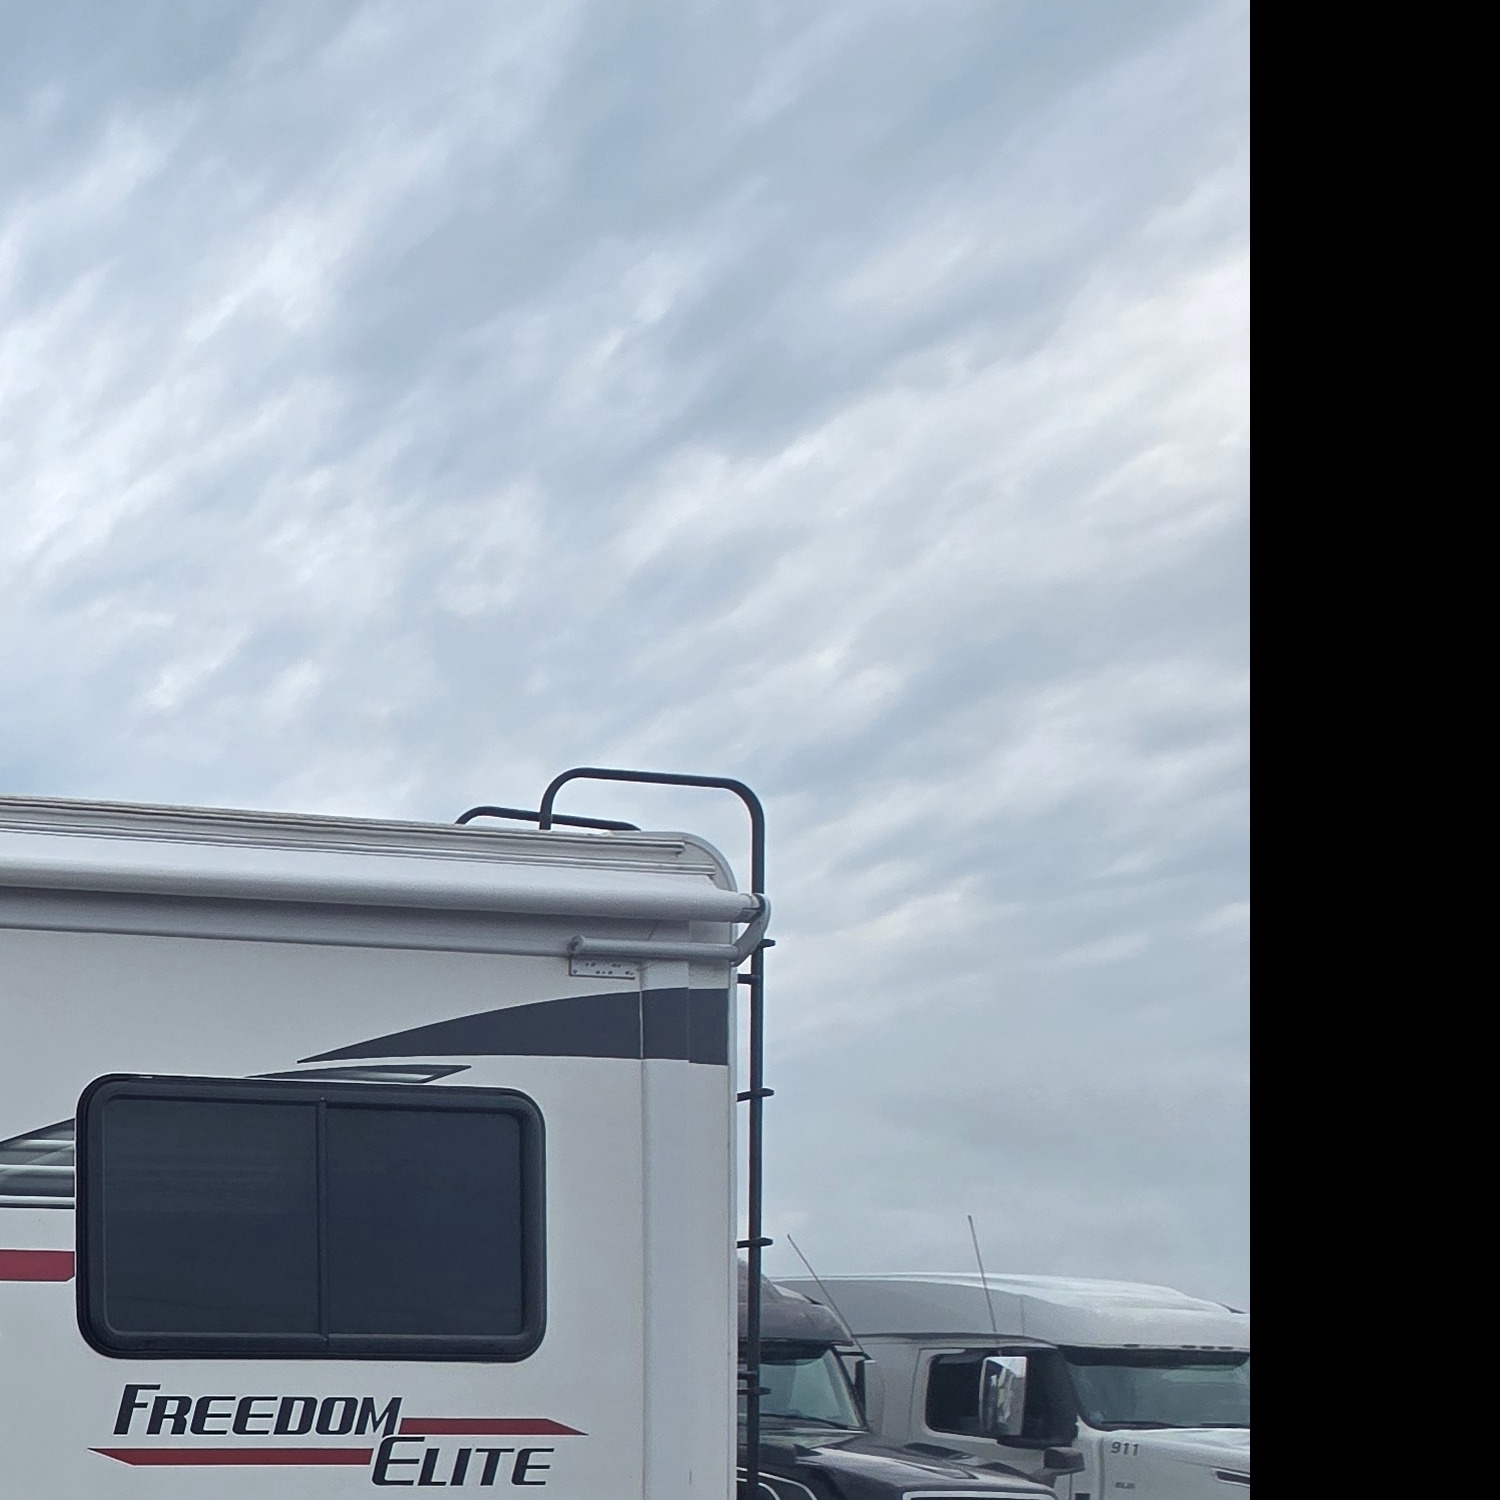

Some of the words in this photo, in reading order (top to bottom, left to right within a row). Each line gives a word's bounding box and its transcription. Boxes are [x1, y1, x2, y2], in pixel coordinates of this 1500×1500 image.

[112, 1383, 403, 1436] FREEDOM
[371, 1435, 555, 1487] ELITE
[1110, 1441, 1140, 1457] 911
